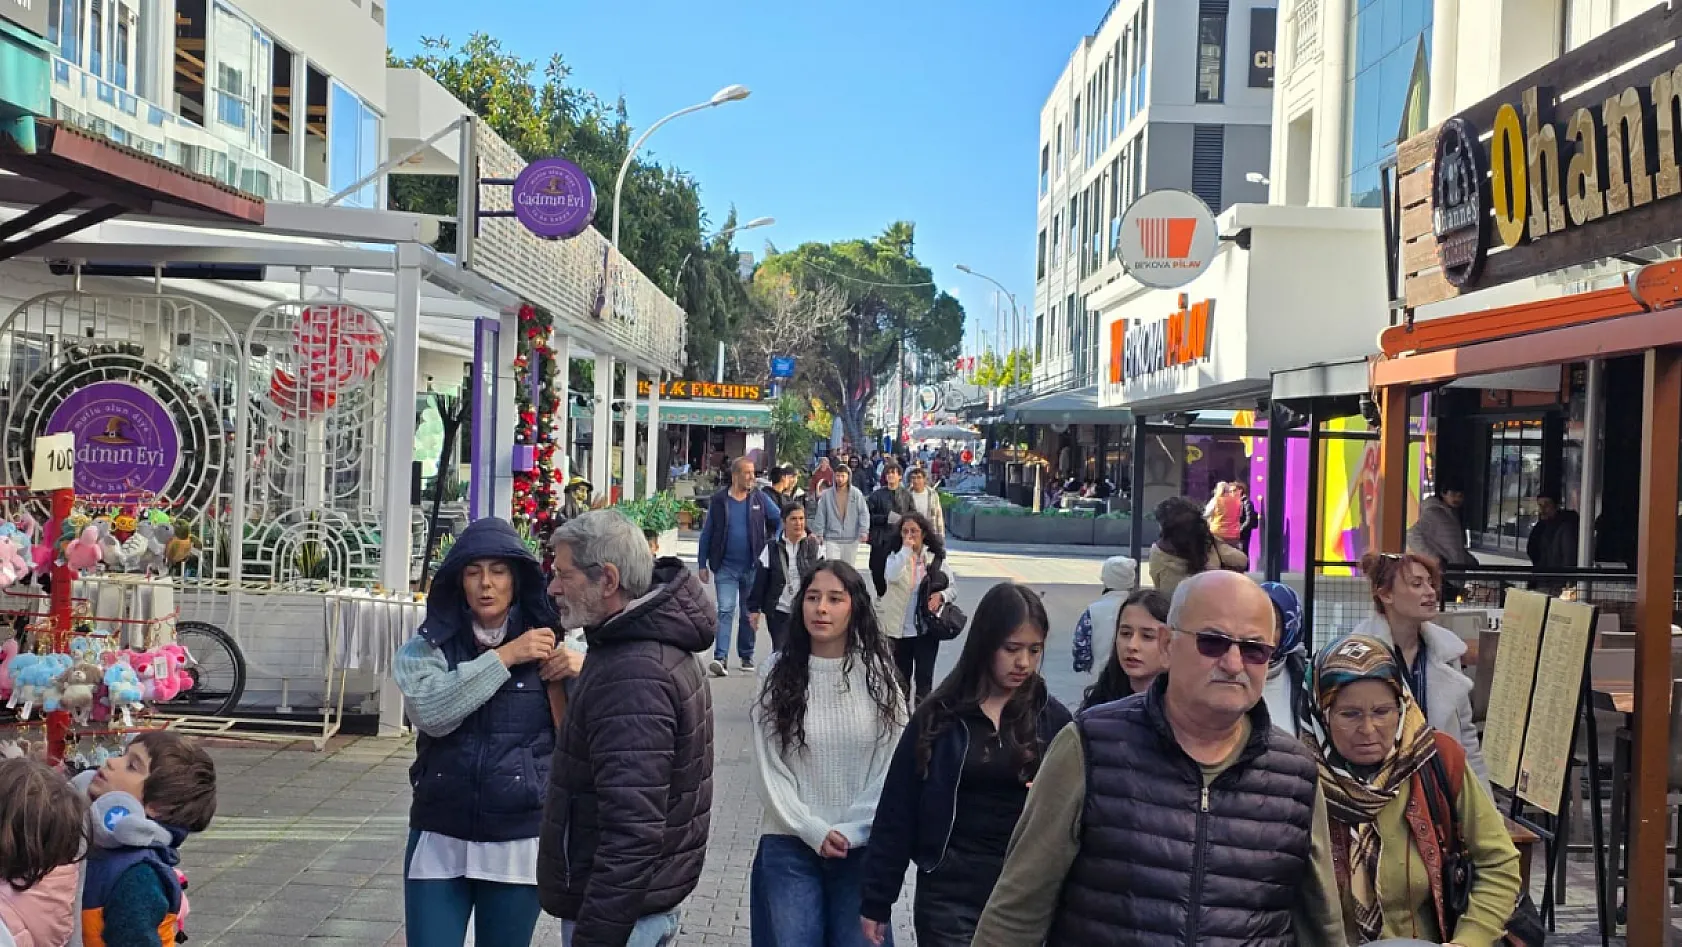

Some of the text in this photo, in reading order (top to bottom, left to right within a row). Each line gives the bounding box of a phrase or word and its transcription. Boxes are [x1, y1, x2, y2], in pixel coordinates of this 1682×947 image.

[567, 194, 584, 208] Evi
[105, 403, 129, 415] olun
[46, 449, 73, 472] 100
[136, 446, 166, 468] Evi
